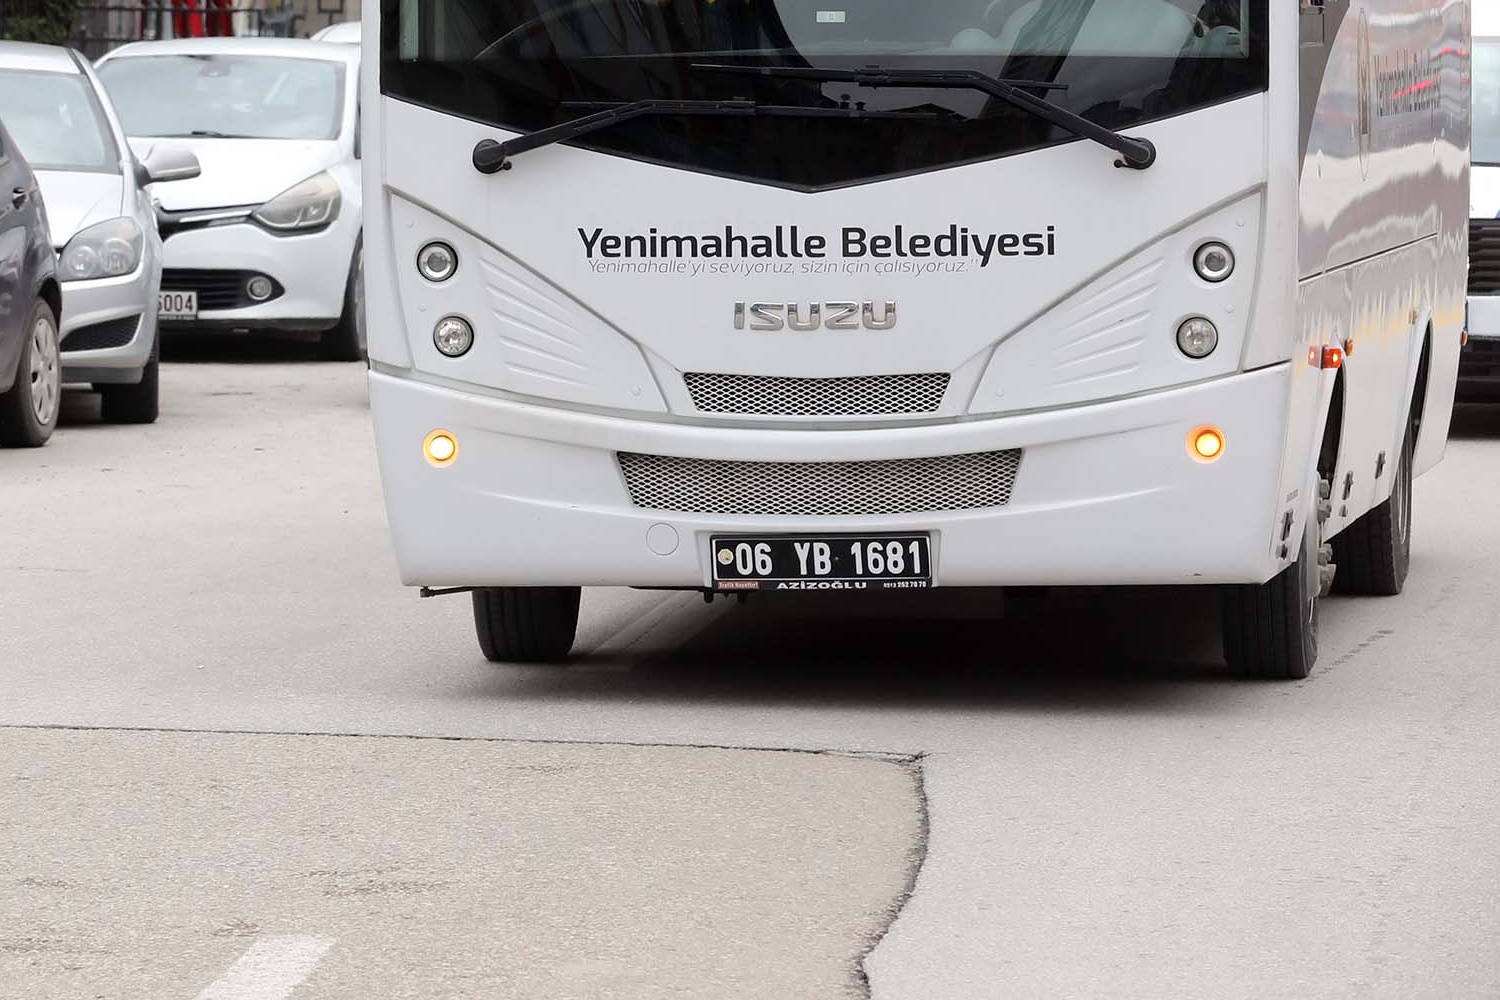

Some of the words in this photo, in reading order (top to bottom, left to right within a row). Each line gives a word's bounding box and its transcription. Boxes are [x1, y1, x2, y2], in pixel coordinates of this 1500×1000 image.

[577, 225, 826, 258] Yenimahalle
[842, 224, 1055, 267] Belediyesi
[588, 259, 706, 277] Yenimahalle'yi
[709, 260, 795, 277] seviyoruz,
[801, 261, 838, 274] sizin
[842, 260, 870, 276] için
[734, 301, 897, 331] ISUZU
[735, 542, 773, 576] 06
[794, 542, 832, 575] YB
[851, 540, 921, 575] 1681
[776, 580, 867, 590] AZİZOĞLU
